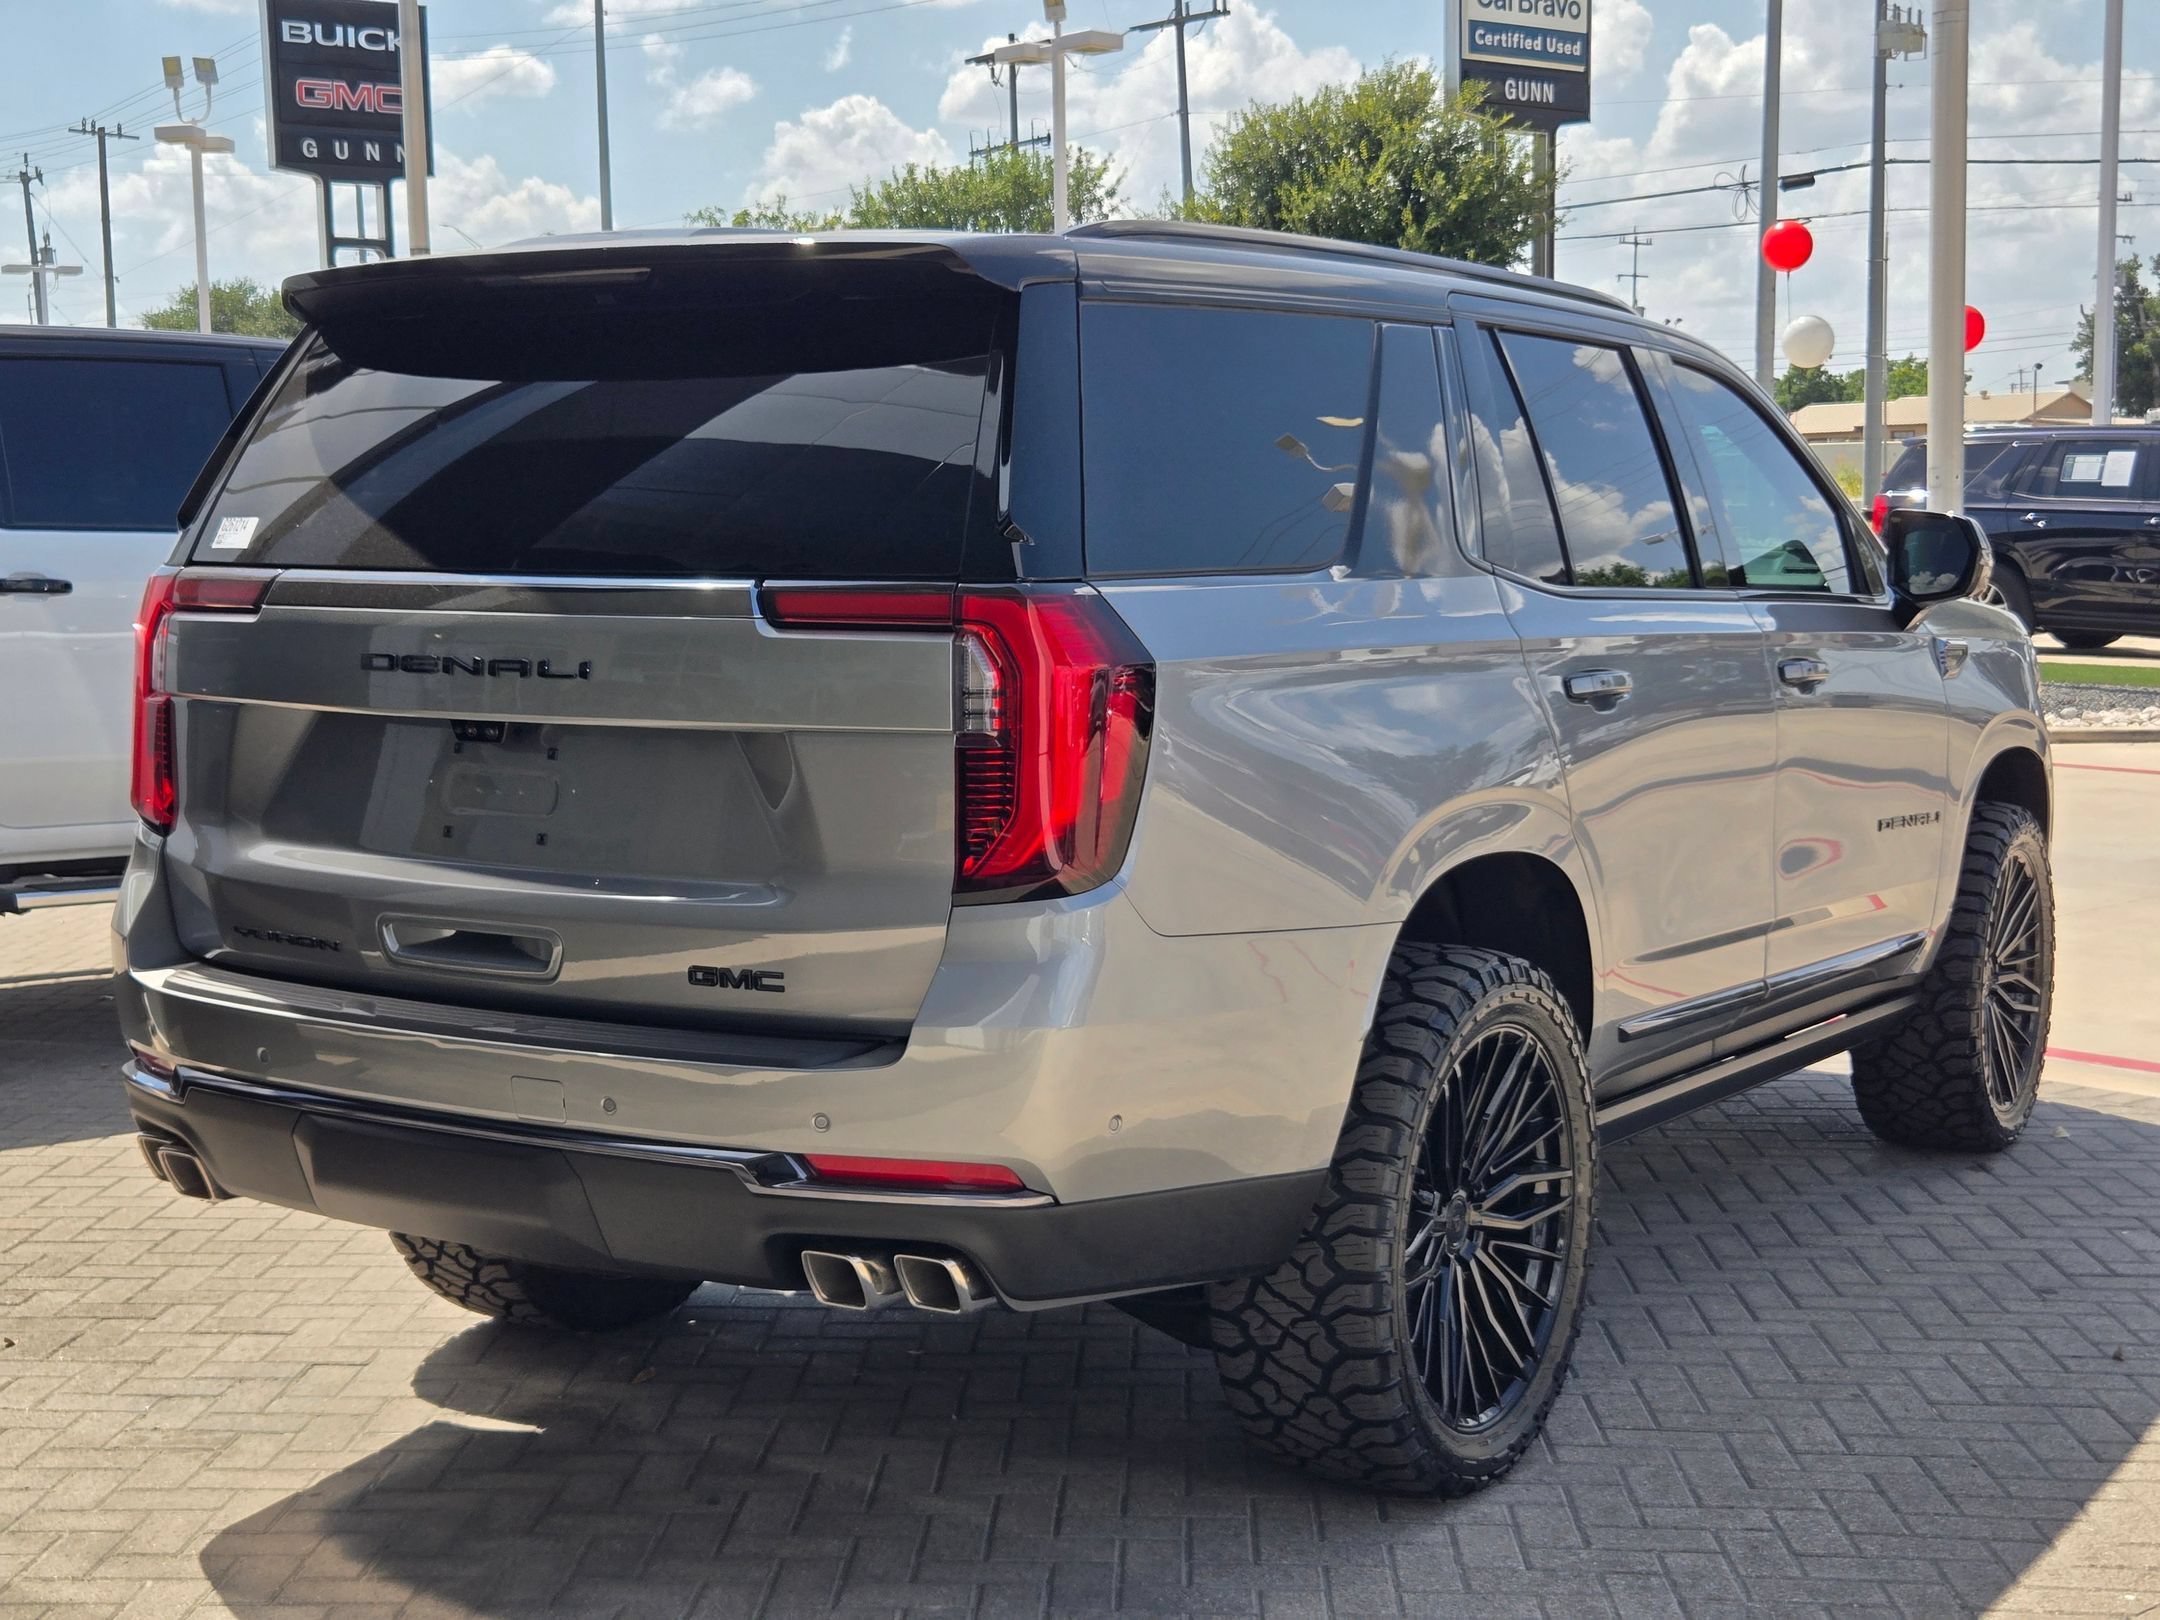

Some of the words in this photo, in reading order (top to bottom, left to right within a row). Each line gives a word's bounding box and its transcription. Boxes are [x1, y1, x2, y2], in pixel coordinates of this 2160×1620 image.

[1474, 28, 1541, 51] Certified
[1546, 36, 1582, 56] Used
[296, 79, 403, 114] GMC
[1504, 78, 1555, 104] GUNN
[360, 652, 592, 680] DENALI
[1877, 810, 1941, 832] DENALI
[233, 925, 341, 952] YUKON
[687, 964, 786, 993] GMC
